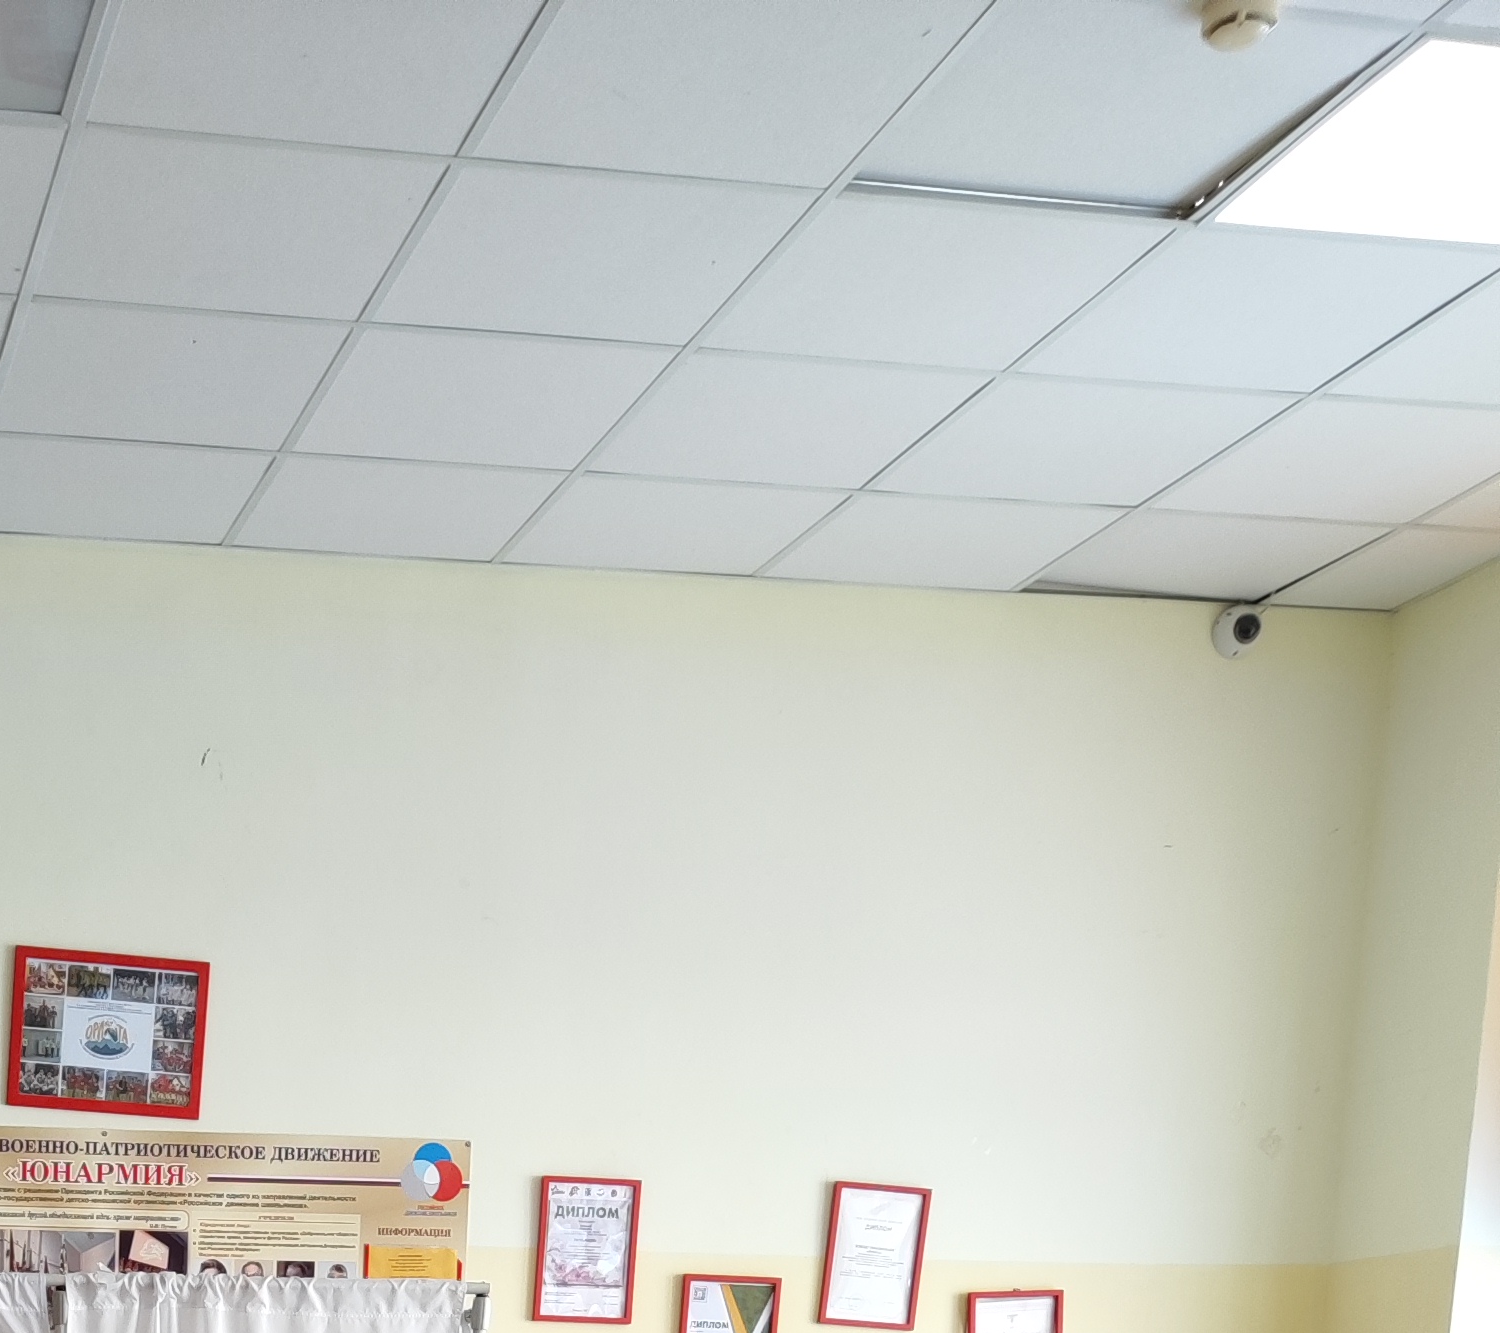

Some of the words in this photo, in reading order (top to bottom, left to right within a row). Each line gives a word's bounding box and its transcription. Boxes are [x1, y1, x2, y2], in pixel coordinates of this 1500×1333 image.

[270, 1145, 381, 1164] ДВИЖЕНИЕ
[2, 1160, 200, 1187] «ЮНАРМИЯ»
[554, 1205, 619, 1220] ДИПЛОМ
